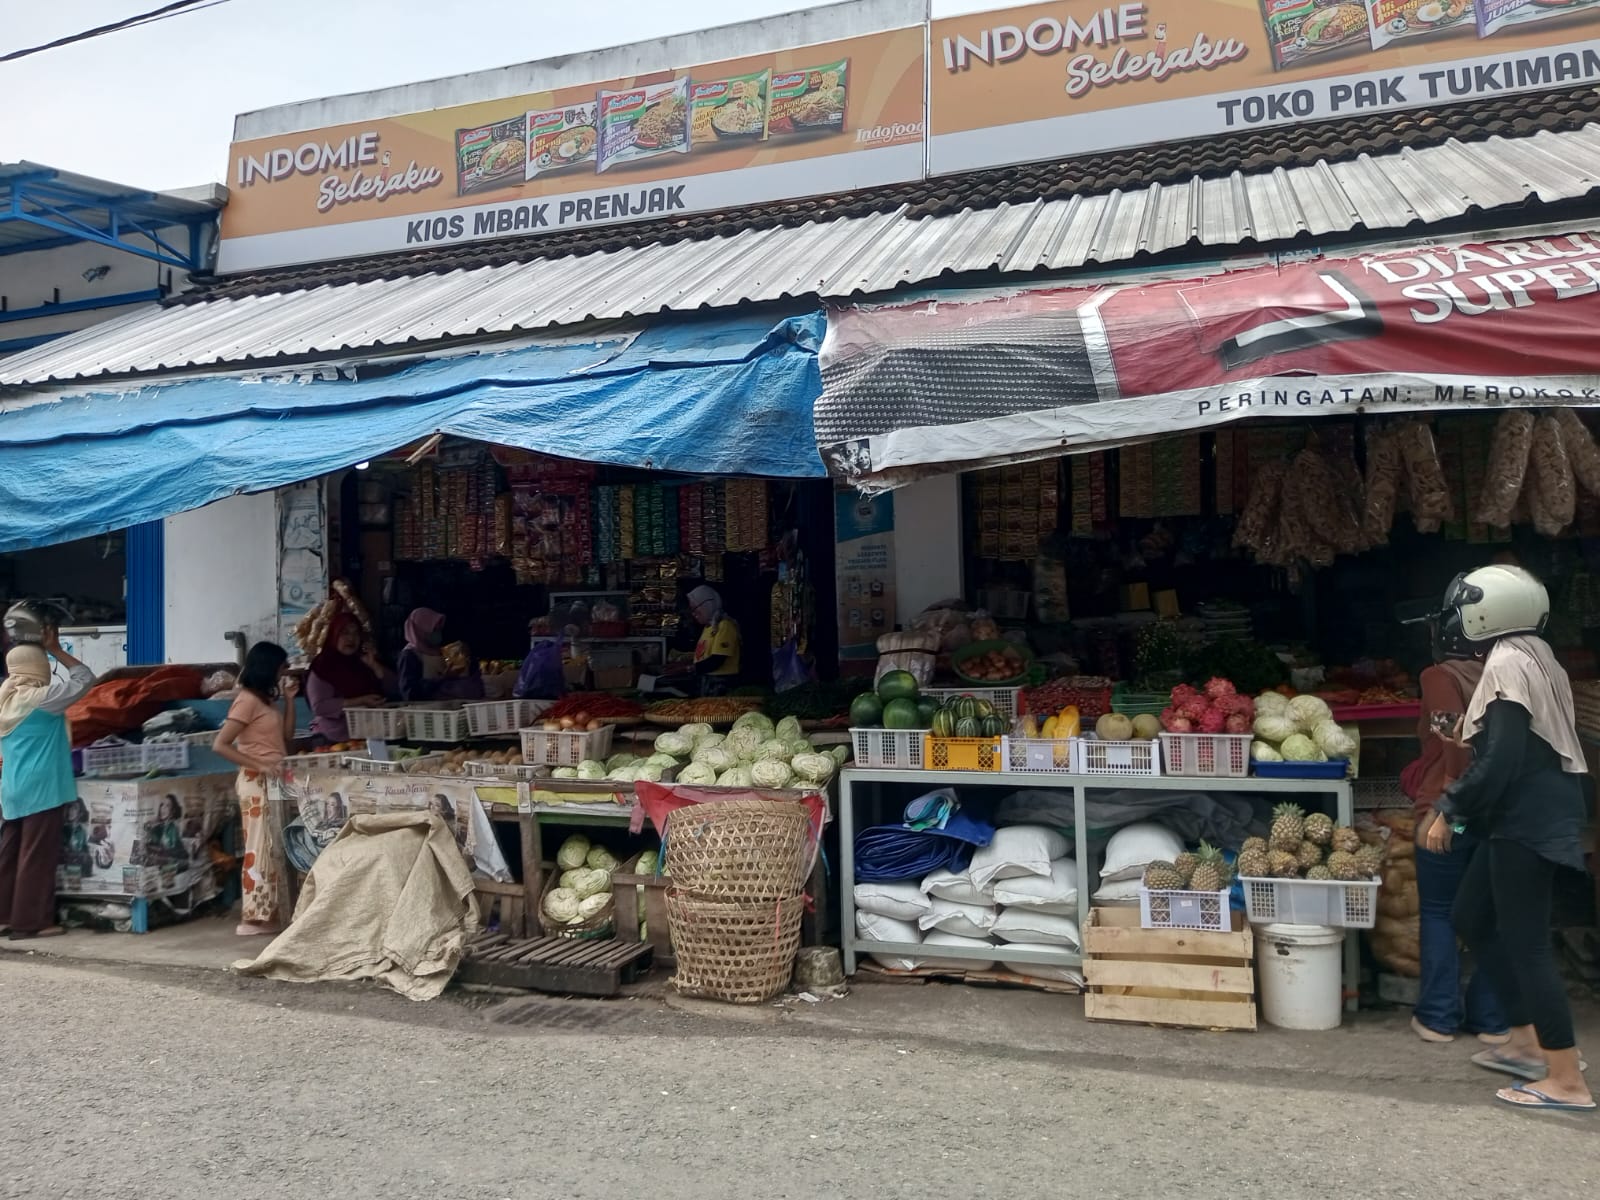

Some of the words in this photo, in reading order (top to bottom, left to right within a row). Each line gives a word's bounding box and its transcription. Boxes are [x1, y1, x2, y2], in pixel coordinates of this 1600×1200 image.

[943, 2, 1146, 70] INDOMIE
[1065, 32, 1247, 97] Seleraku
[1217, 89, 1314, 126] TOKO
[1329, 75, 1407, 112] PAK
[237, 131, 380, 187] INDOMIE
[316, 159, 441, 211] Seleraku
[406, 214, 464, 244] KIOS
[473, 203, 549, 236] MBAK
[558, 184, 686, 225] PRENJAK
[1197, 386, 1412, 416] PERINGATAN:
